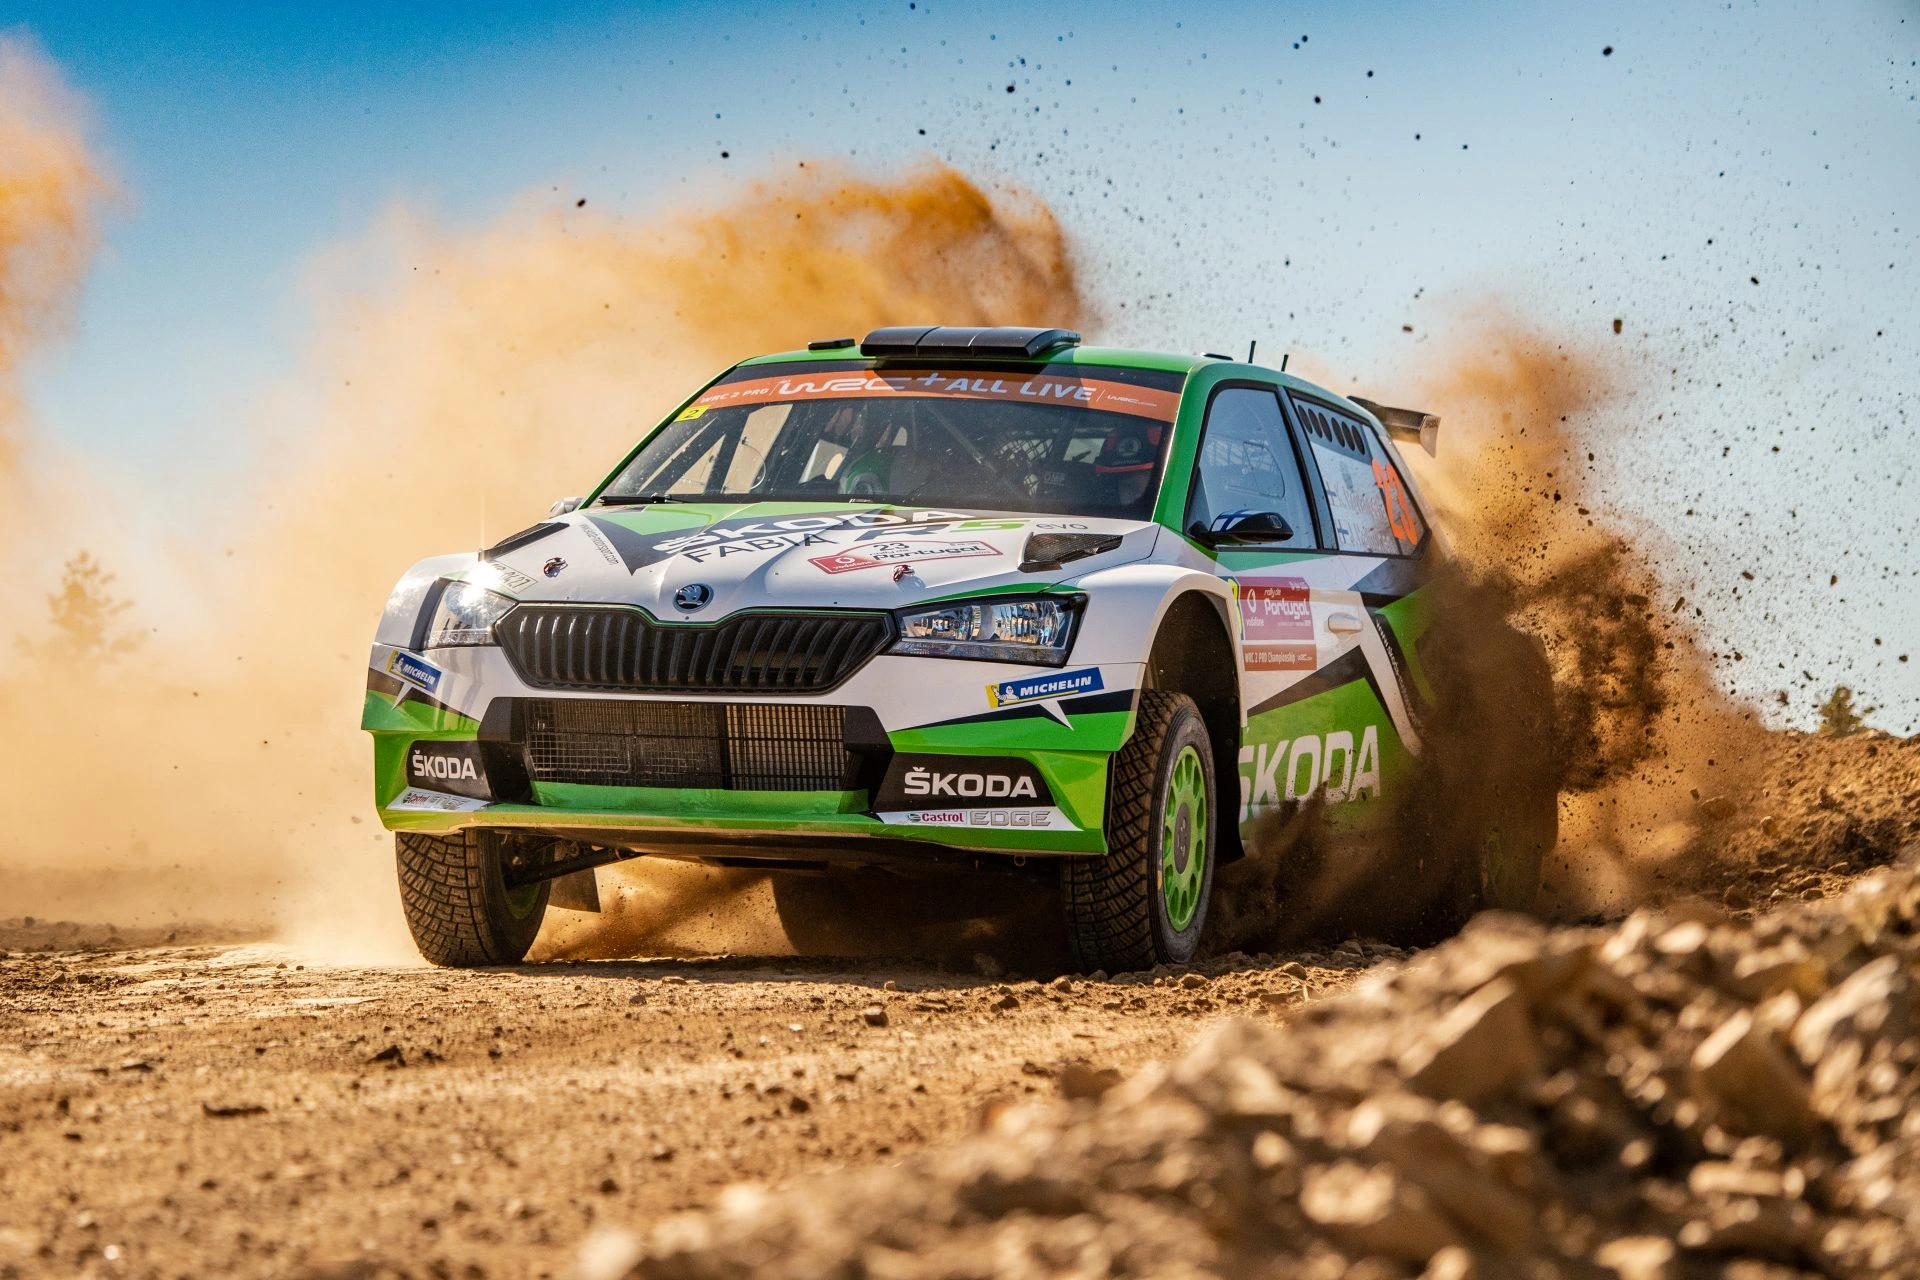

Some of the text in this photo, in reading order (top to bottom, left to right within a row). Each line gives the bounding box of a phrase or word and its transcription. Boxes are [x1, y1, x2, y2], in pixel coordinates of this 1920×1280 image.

[701, 393, 729, 403] WRC
[742, 387, 769, 396] PRO
[945, 377, 1008, 393] ALL
[1020, 381, 1097, 400] LIVE
[684, 409, 699, 419] 2
[653, 510, 975, 554] ŠKODA
[681, 532, 838, 562] FABIA
[873, 542, 910, 551] 23
[873, 545, 986, 560] Portugal
[1264, 598, 1310, 620] Portugal
[1267, 652, 1296, 665] Championship
[403, 663, 436, 686] MICHELIN
[1020, 676, 1092, 697] MICHELIN
[412, 749, 478, 780] ŠKODA
[904, 766, 1038, 798] ŠKODA
[922, 810, 1052, 827] Castrol EDGE
